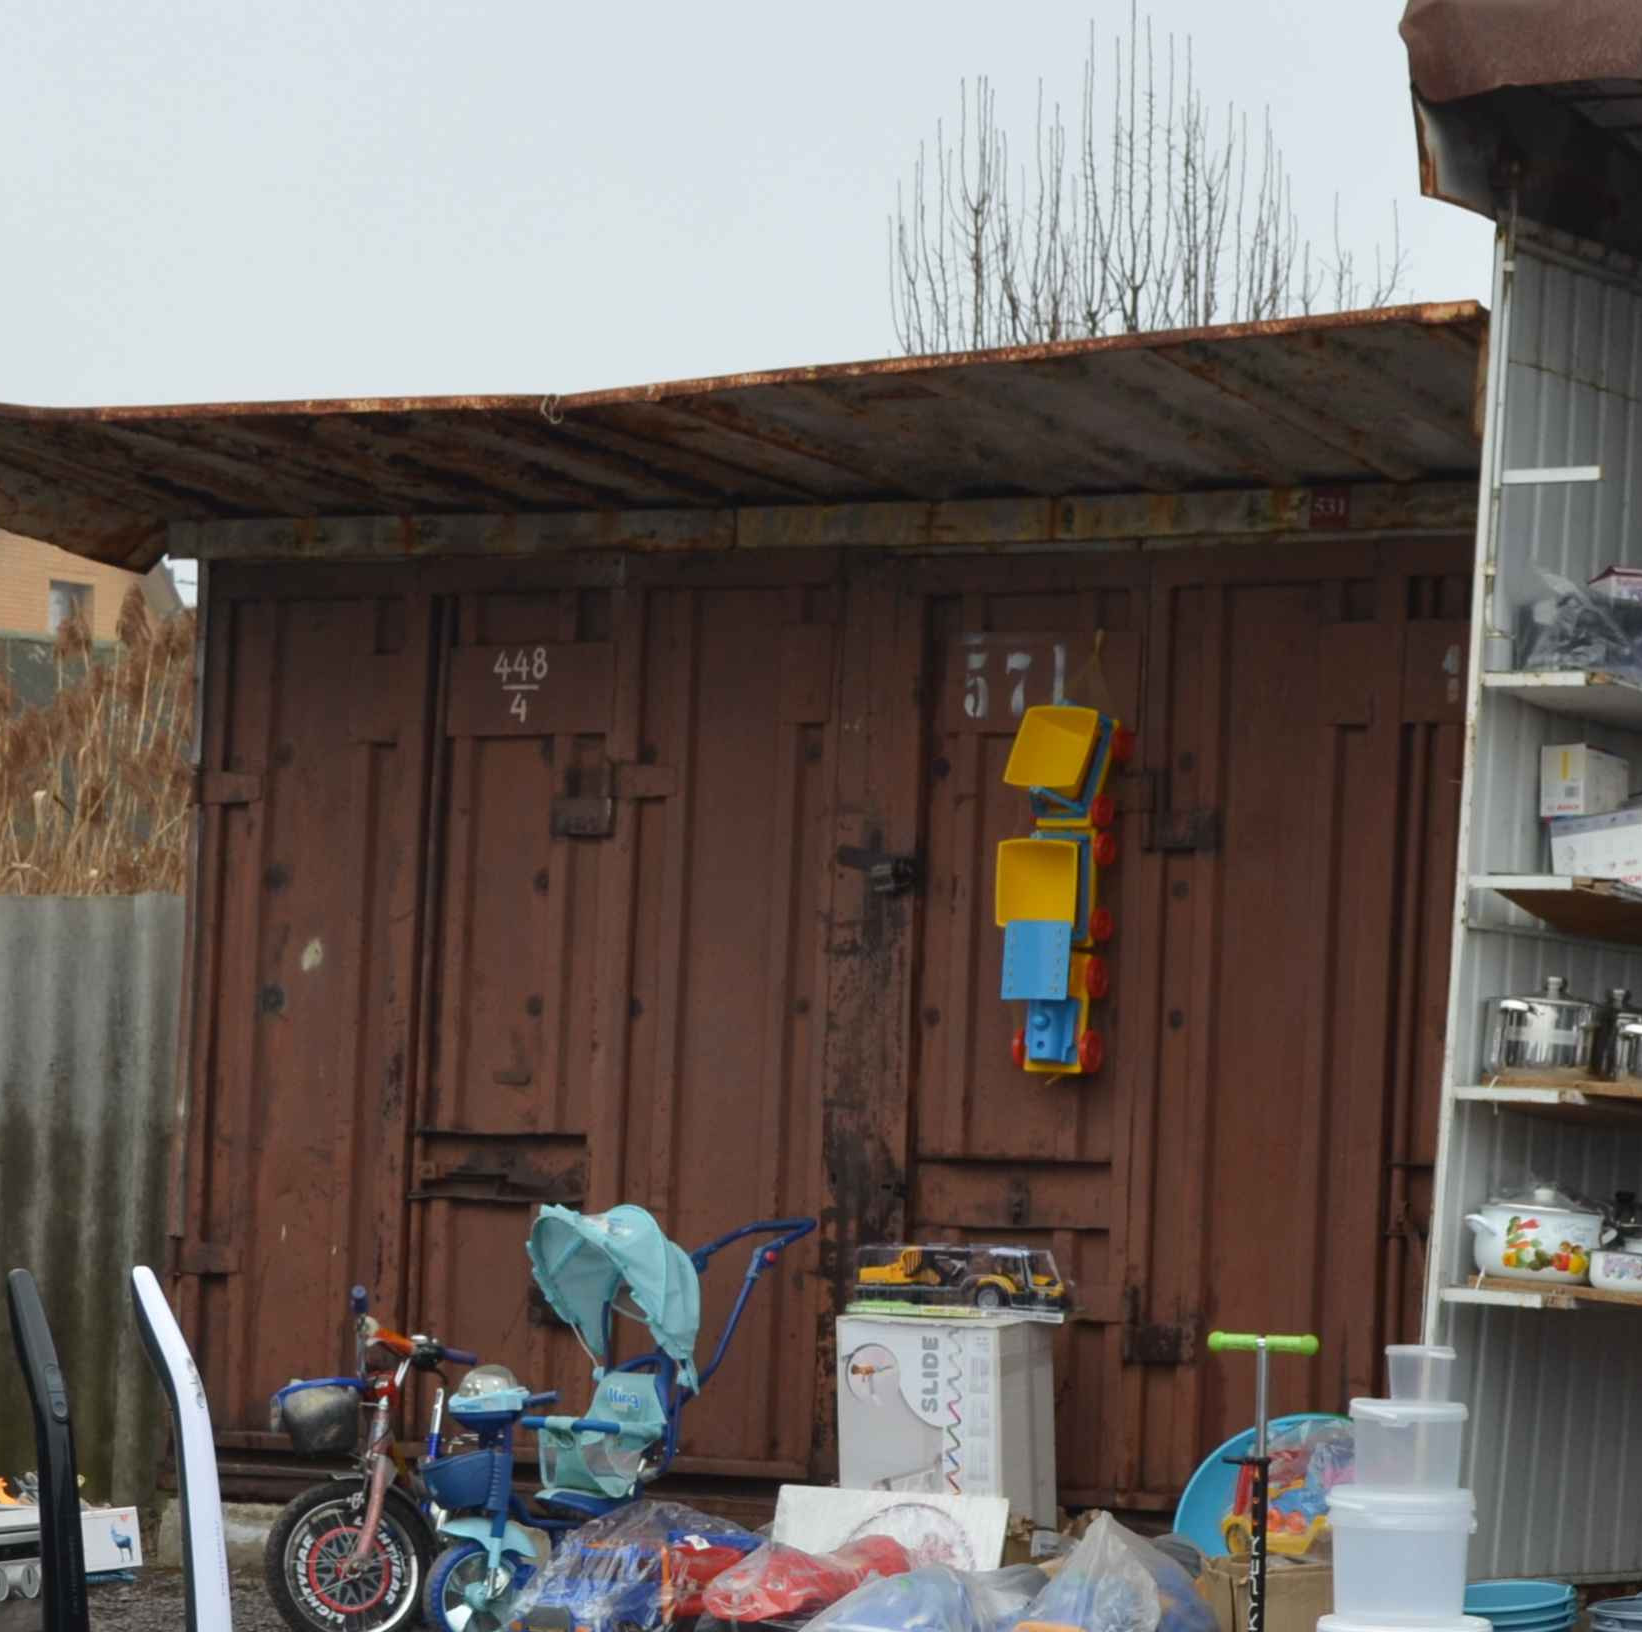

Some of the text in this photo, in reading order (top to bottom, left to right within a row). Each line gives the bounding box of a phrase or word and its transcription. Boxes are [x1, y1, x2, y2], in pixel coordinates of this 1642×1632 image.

[492, 646, 549, 682] 448
[963, 643, 1064, 718] 571
[509, 692, 528, 723] 4
[921, 1336, 940, 1414] SLIDE
